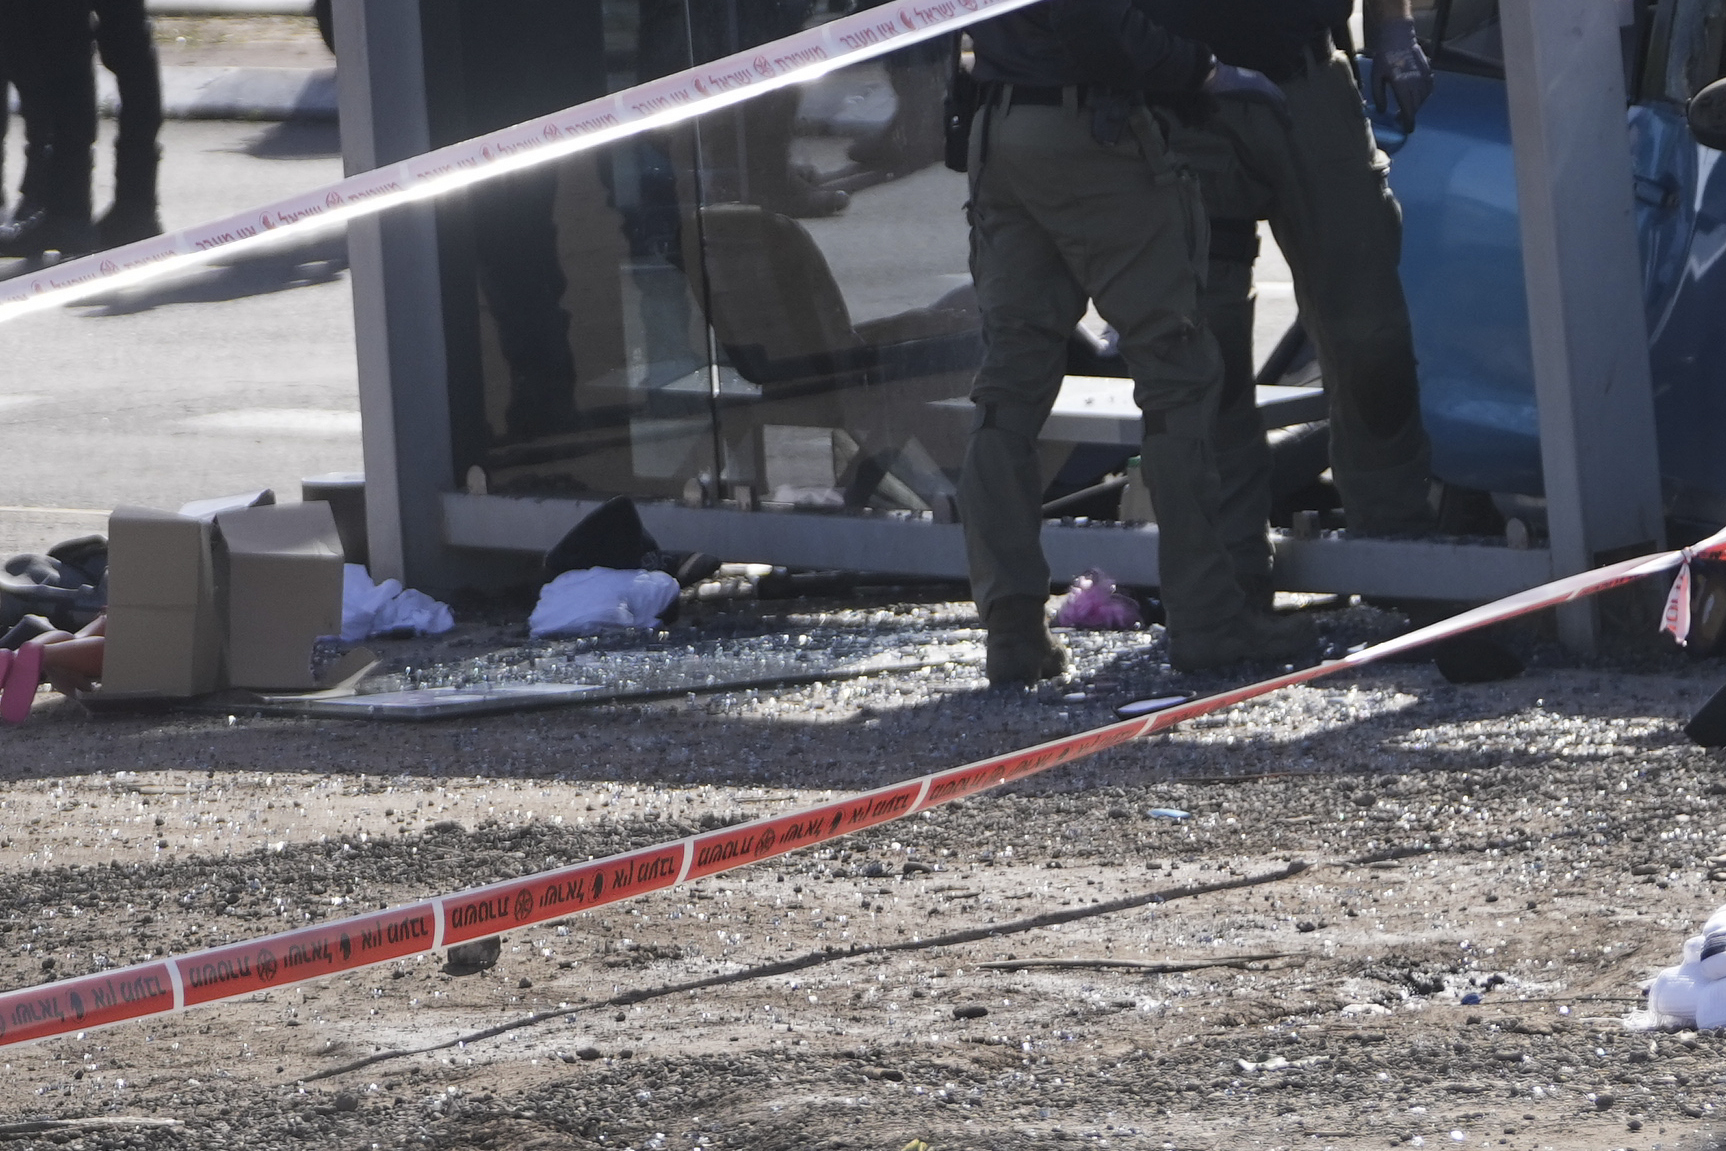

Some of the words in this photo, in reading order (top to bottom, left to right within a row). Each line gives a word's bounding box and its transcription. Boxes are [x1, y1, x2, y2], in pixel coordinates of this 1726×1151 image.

[693, 833, 756, 867] משטרת
[448, 895, 513, 930] משטרת
[535, 876, 587, 912] ישראל
[633, 854, 677, 882] מעבר
[187, 953, 253, 990] משטרת
[280, 938, 333, 967] ישראל
[356, 920, 385, 950] אין
[384, 912, 429, 944] מעבר
[8, 994, 65, 1032] ישראל
[89, 979, 118, 1012] אין
[116, 970, 166, 1005] מעבר
